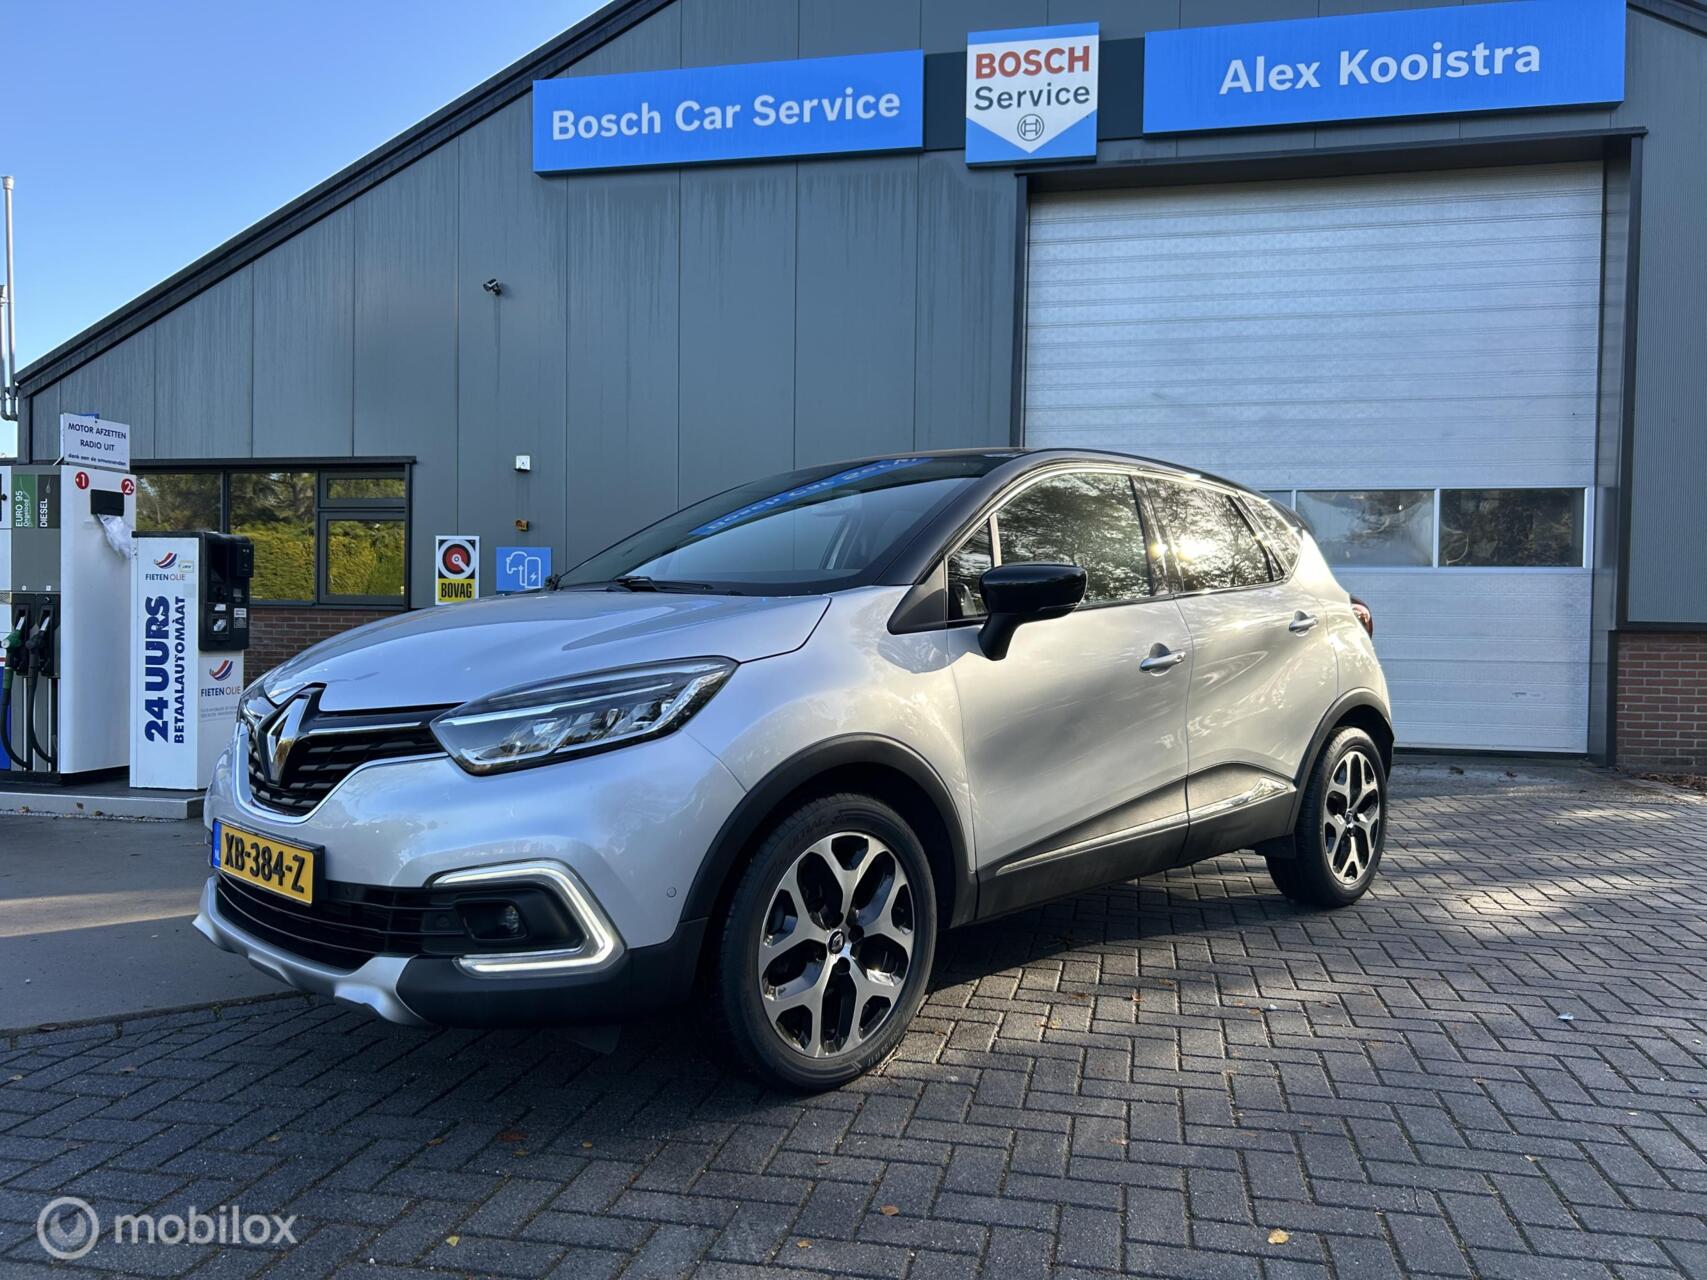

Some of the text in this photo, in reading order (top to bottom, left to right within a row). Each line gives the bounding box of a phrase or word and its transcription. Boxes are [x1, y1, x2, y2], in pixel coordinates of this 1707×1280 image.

[974, 45, 1091, 80] BOSCH
[1219, 41, 1540, 95] Alex Kooistra
[973, 82, 1091, 112] Service
[551, 87, 901, 141] Bosch Car Service
[68, 423, 127, 440] MOTOR AFZETTEN
[80, 439, 115, 452] RADIO UIT
[15, 490, 23, 527] EURO 95
[39, 498, 48, 527] DIESEL
[145, 573, 186, 581] FIETEN OLIE
[441, 582, 472, 599] BOVAG
[144, 595, 170, 744] 24 UURS
[200, 686, 241, 697] FIETEN OLIE
[225, 832, 306, 894] XB-384-Z
